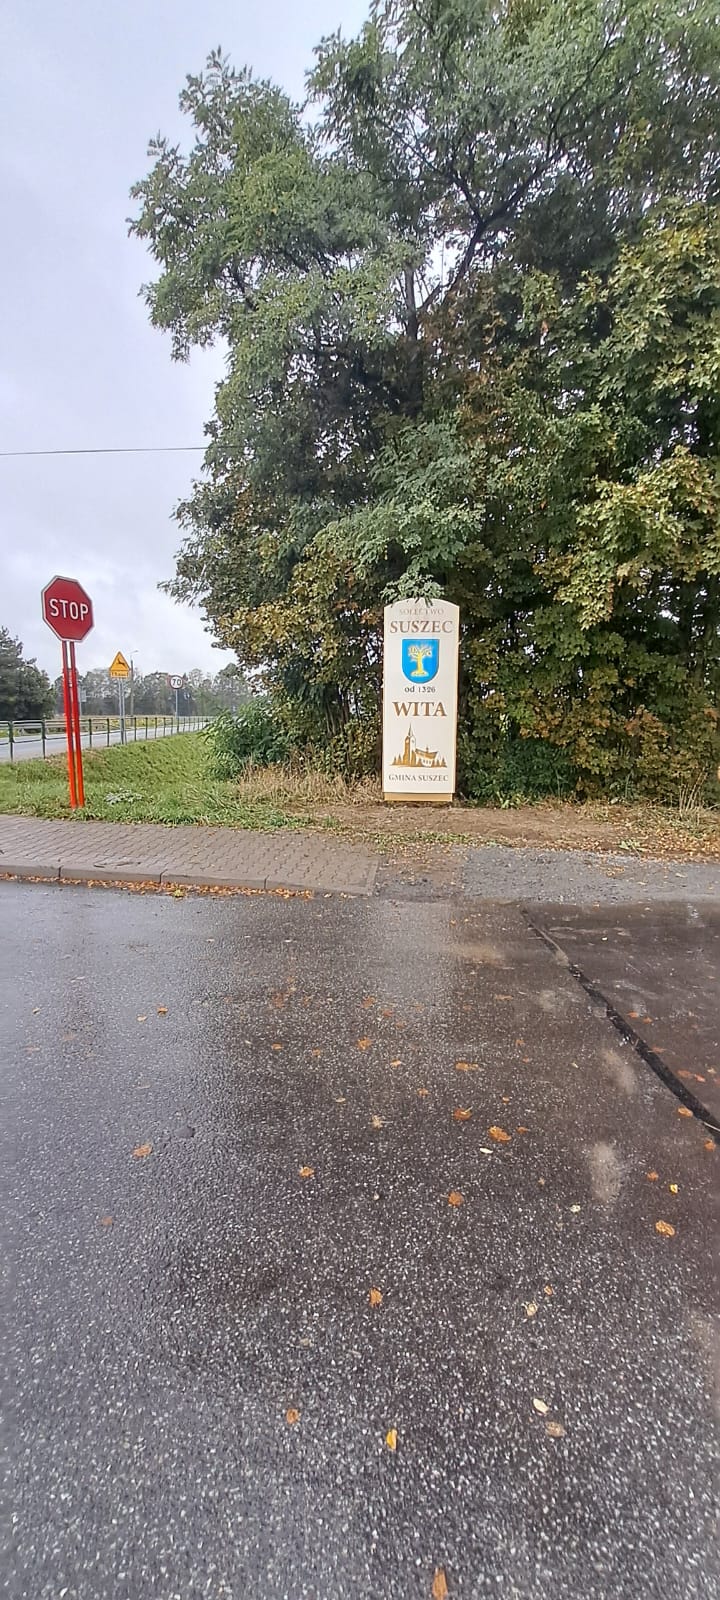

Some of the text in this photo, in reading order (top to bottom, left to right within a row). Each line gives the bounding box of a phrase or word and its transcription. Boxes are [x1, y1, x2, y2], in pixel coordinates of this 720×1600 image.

[50, 598, 89, 621] STOP
[390, 620, 453, 634] SUSZEC
[172, 678, 181, 686] 70
[392, 701, 448, 717] WITA
[388, 774, 449, 782] GMINA SUSZEC
